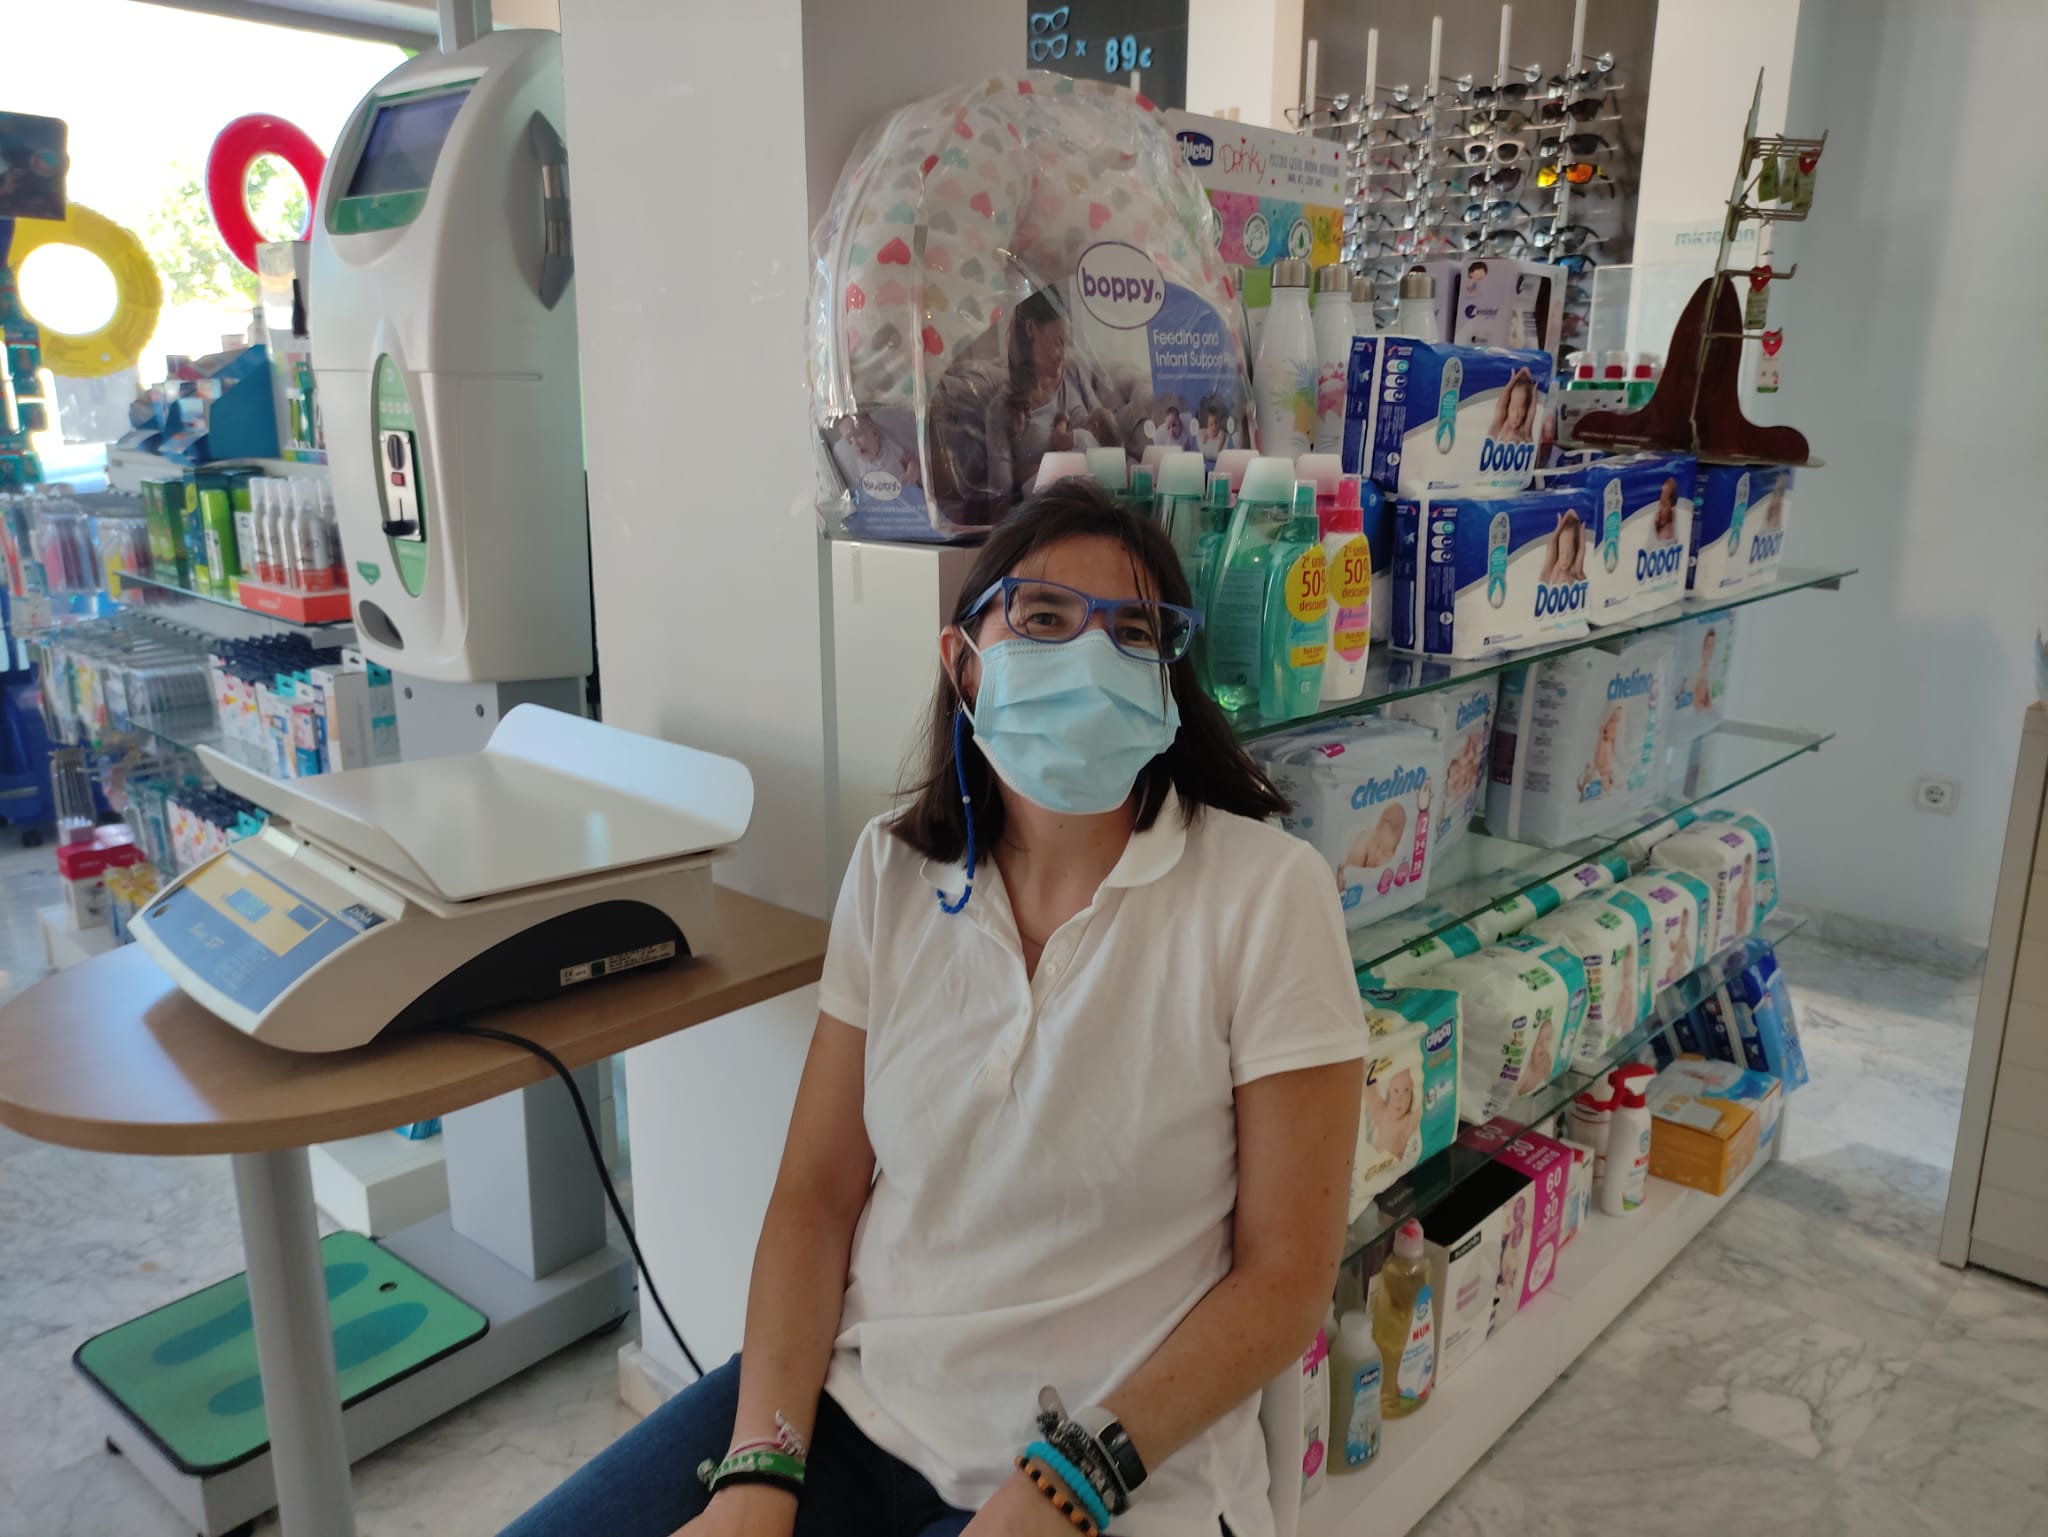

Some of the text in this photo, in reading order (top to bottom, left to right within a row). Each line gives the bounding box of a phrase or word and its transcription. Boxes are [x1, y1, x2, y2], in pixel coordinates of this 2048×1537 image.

[1153, 330, 1219, 349] Feeding and
[1155, 351, 1188, 367] Infant
[1479, 438, 1535, 472] DODOT
[1637, 544, 1683, 582] DODOT
[1749, 531, 1784, 564] DODOT
[1535, 582, 1589, 617] DODOT
[1351, 765, 1427, 810] chelino
[1546, 1166, 1562, 1193] 60
[1543, 1197, 1558, 1225] 30
